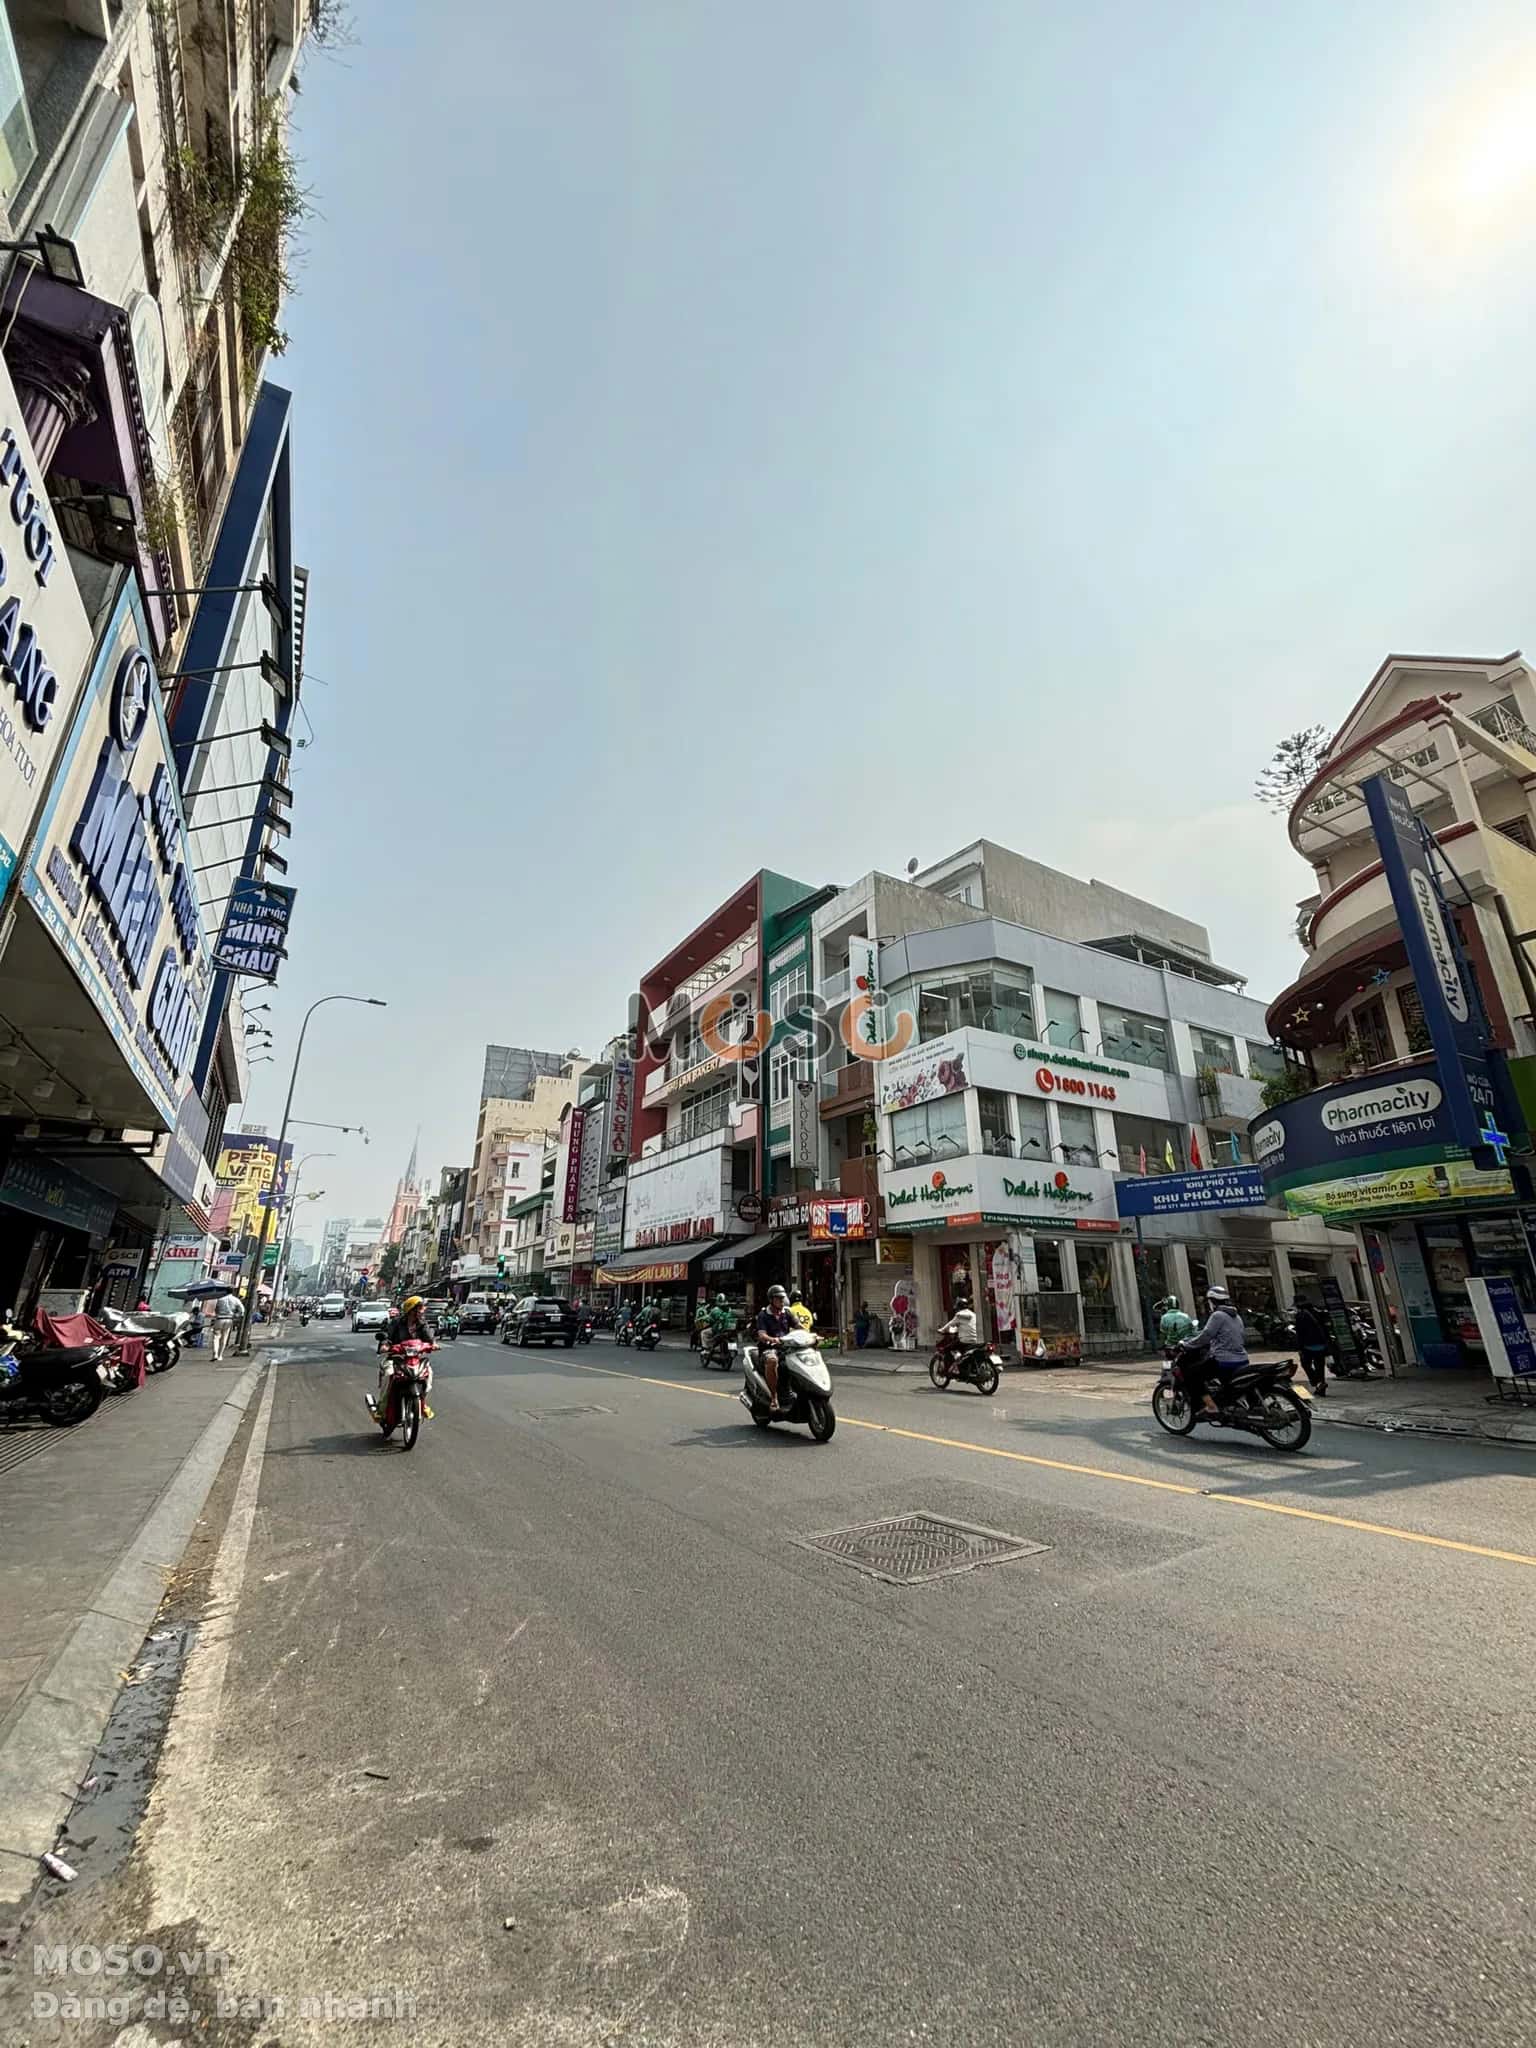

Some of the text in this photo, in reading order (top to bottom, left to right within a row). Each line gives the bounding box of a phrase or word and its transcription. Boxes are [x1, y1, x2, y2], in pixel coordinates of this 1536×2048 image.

[70, 736, 163, 990] MINH
[1414, 877, 1461, 1010] Pharmacity
[1054, 1075, 1086, 1096] 1800
[1327, 1087, 1430, 1126] Pharmacity
[1335, 1116, 1436, 1146] Nhà thuốc tiện lợi
[1003, 1177, 1040, 1197] Dalat
[1186, 1181, 1203, 1189] KHU
[1206, 1178, 1225, 1188] PHỐ
[1336, 1189, 1358, 1201] sung
[1359, 1182, 1398, 1198] vitamin
[1399, 1180, 1415, 1191] D3
[888, 1186, 918, 1208] Dalat
[1154, 1193, 1179, 1204] KHU
[1183, 1187, 1211, 1201] PHỐ
